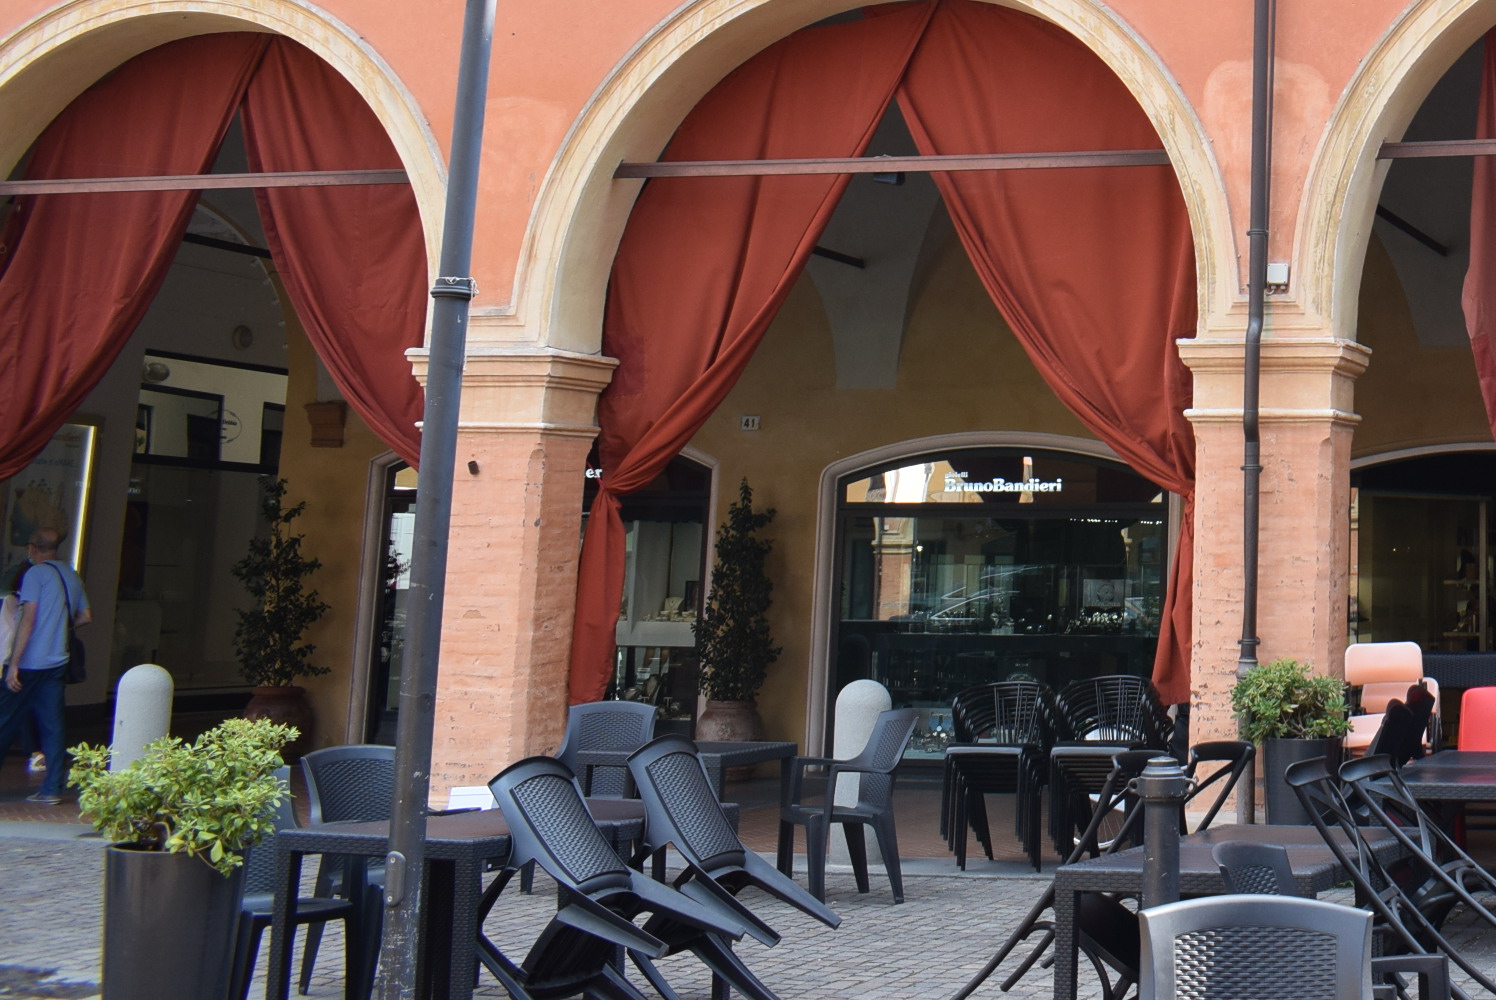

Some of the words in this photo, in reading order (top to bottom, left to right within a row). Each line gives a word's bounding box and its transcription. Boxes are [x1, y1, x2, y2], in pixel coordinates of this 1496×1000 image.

[743, 417, 755, 428] 41
[585, 467, 603, 479] er
[944, 478, 1062, 493] BrunoBandieri
